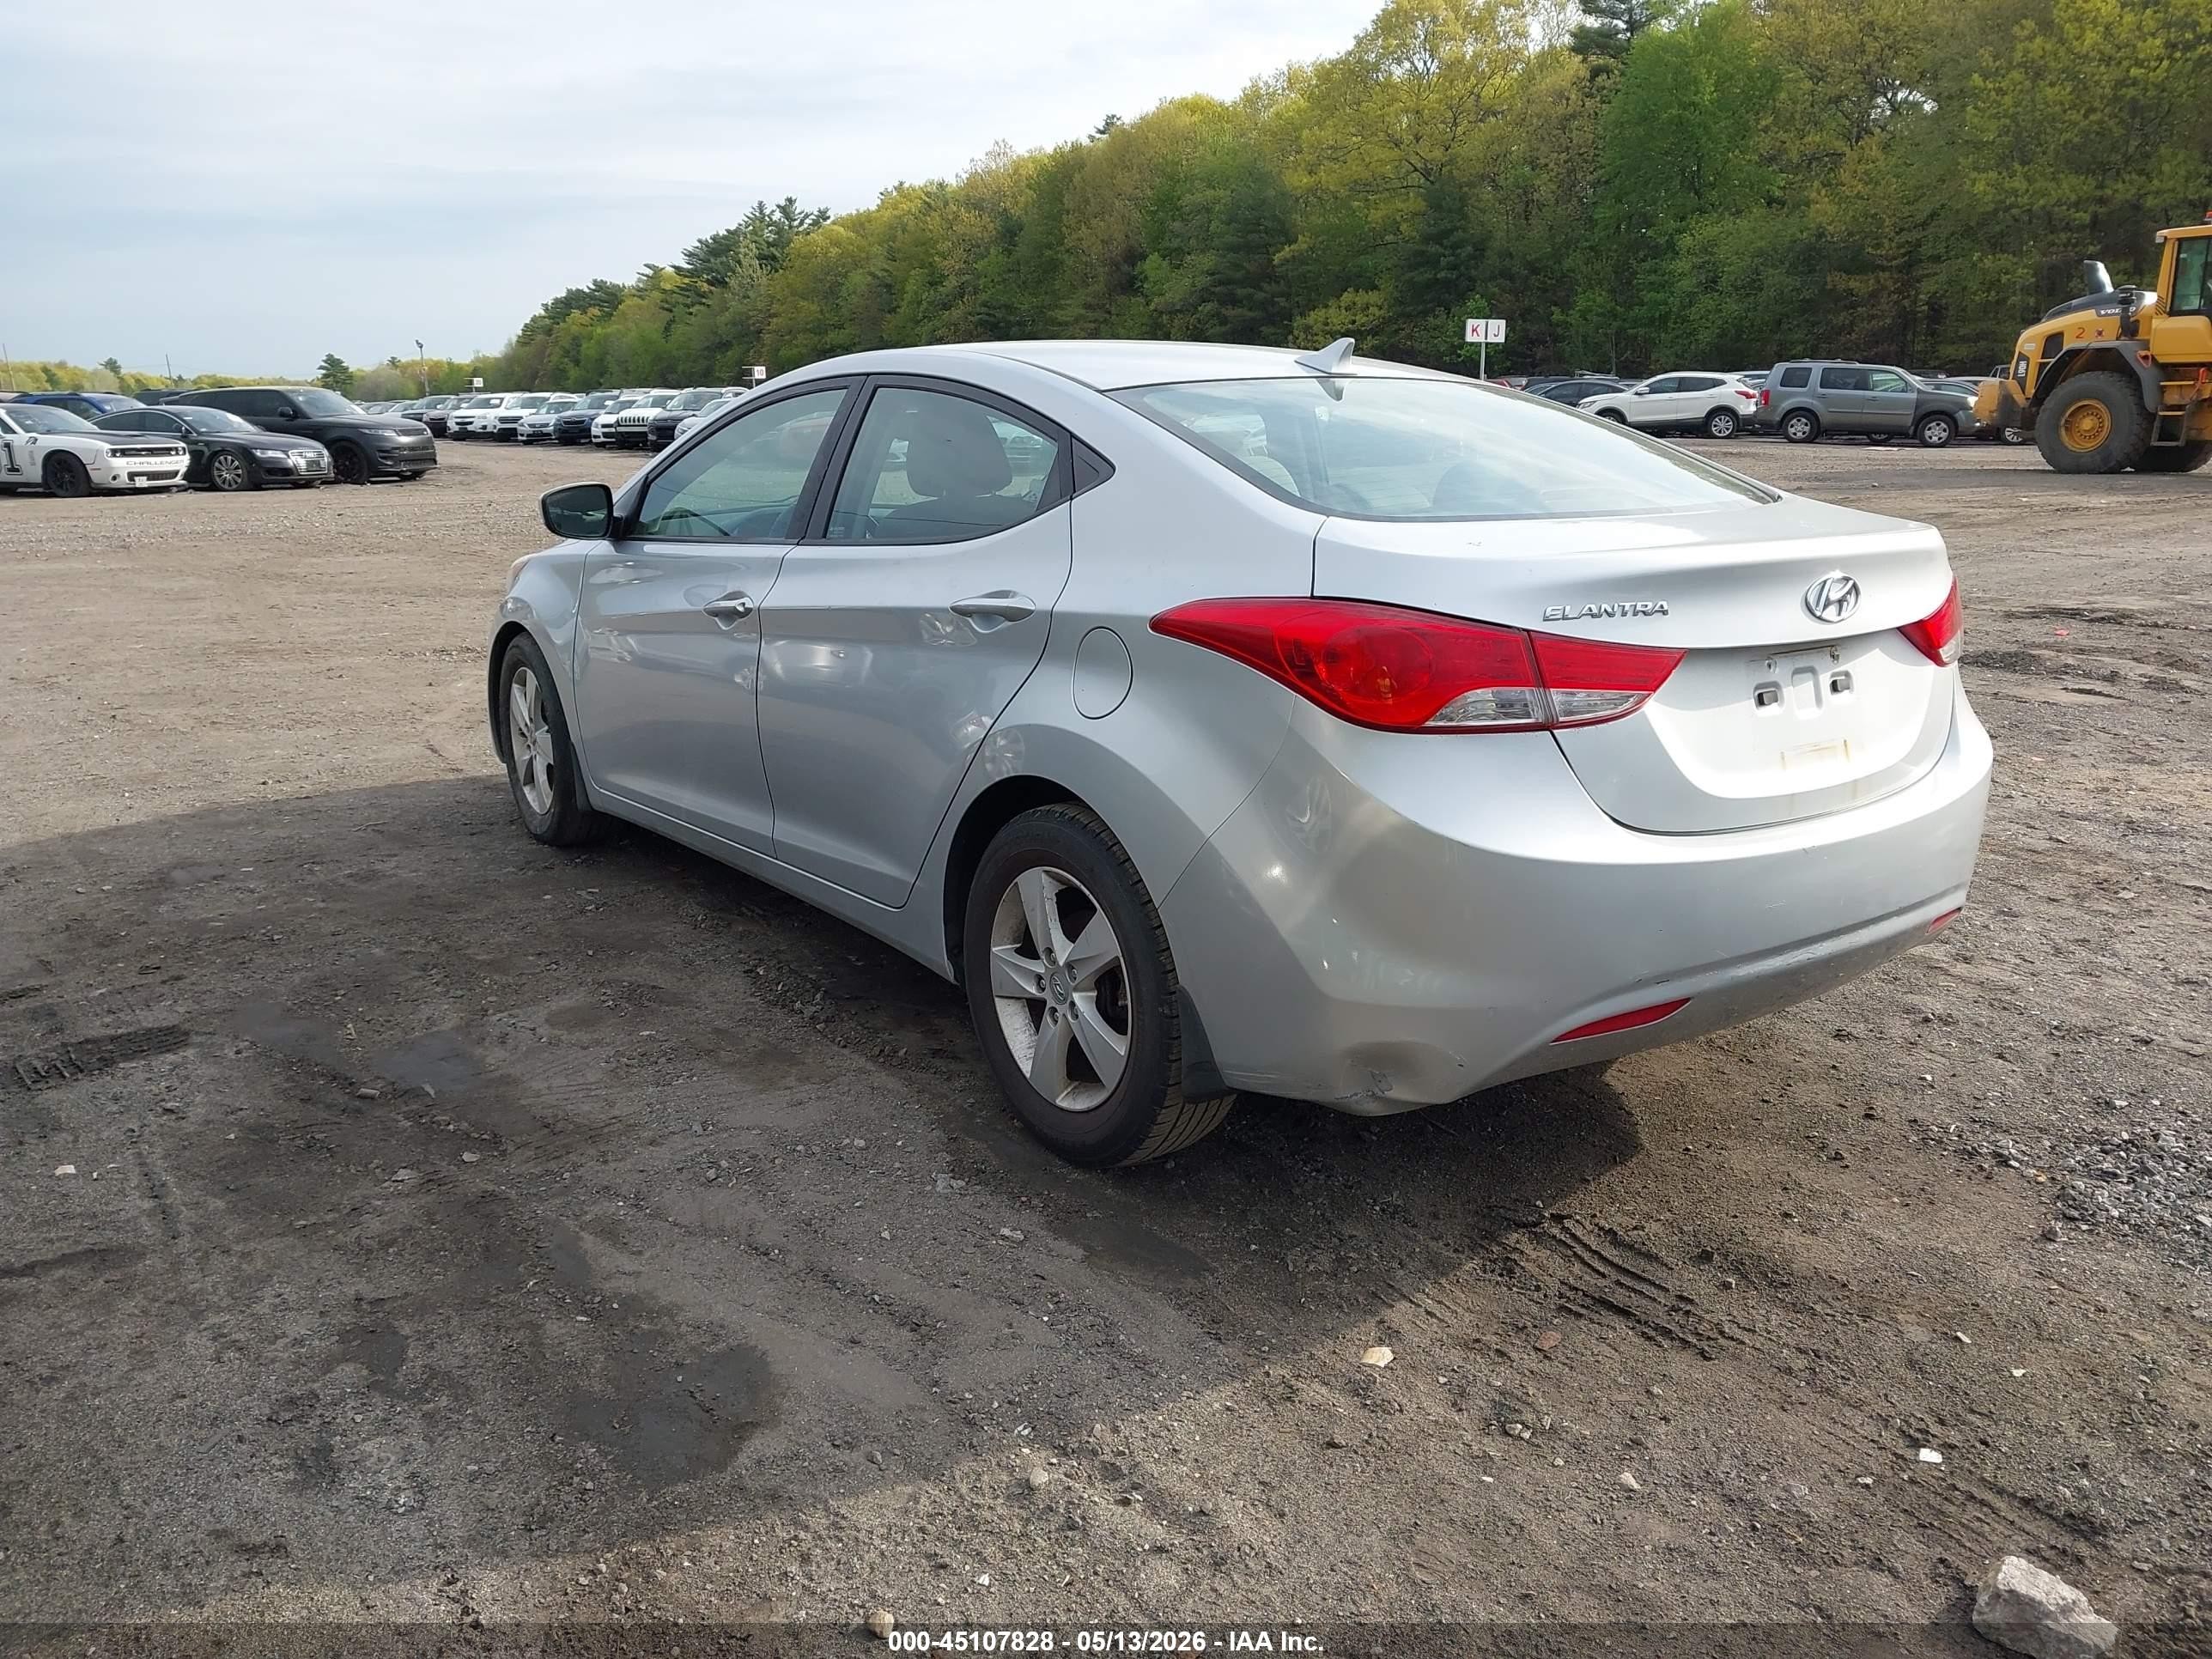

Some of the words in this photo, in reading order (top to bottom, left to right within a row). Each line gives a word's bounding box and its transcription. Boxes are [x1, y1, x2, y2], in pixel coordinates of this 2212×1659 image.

[2100, 307, 2136, 315] VOLO
[1471, 324, 1480, 337] K
[1492, 324, 1500, 337] J
[2075, 327, 2086, 339] 2
[756, 368, 764, 377] 10
[1543, 601, 1670, 622] ELANTRA
